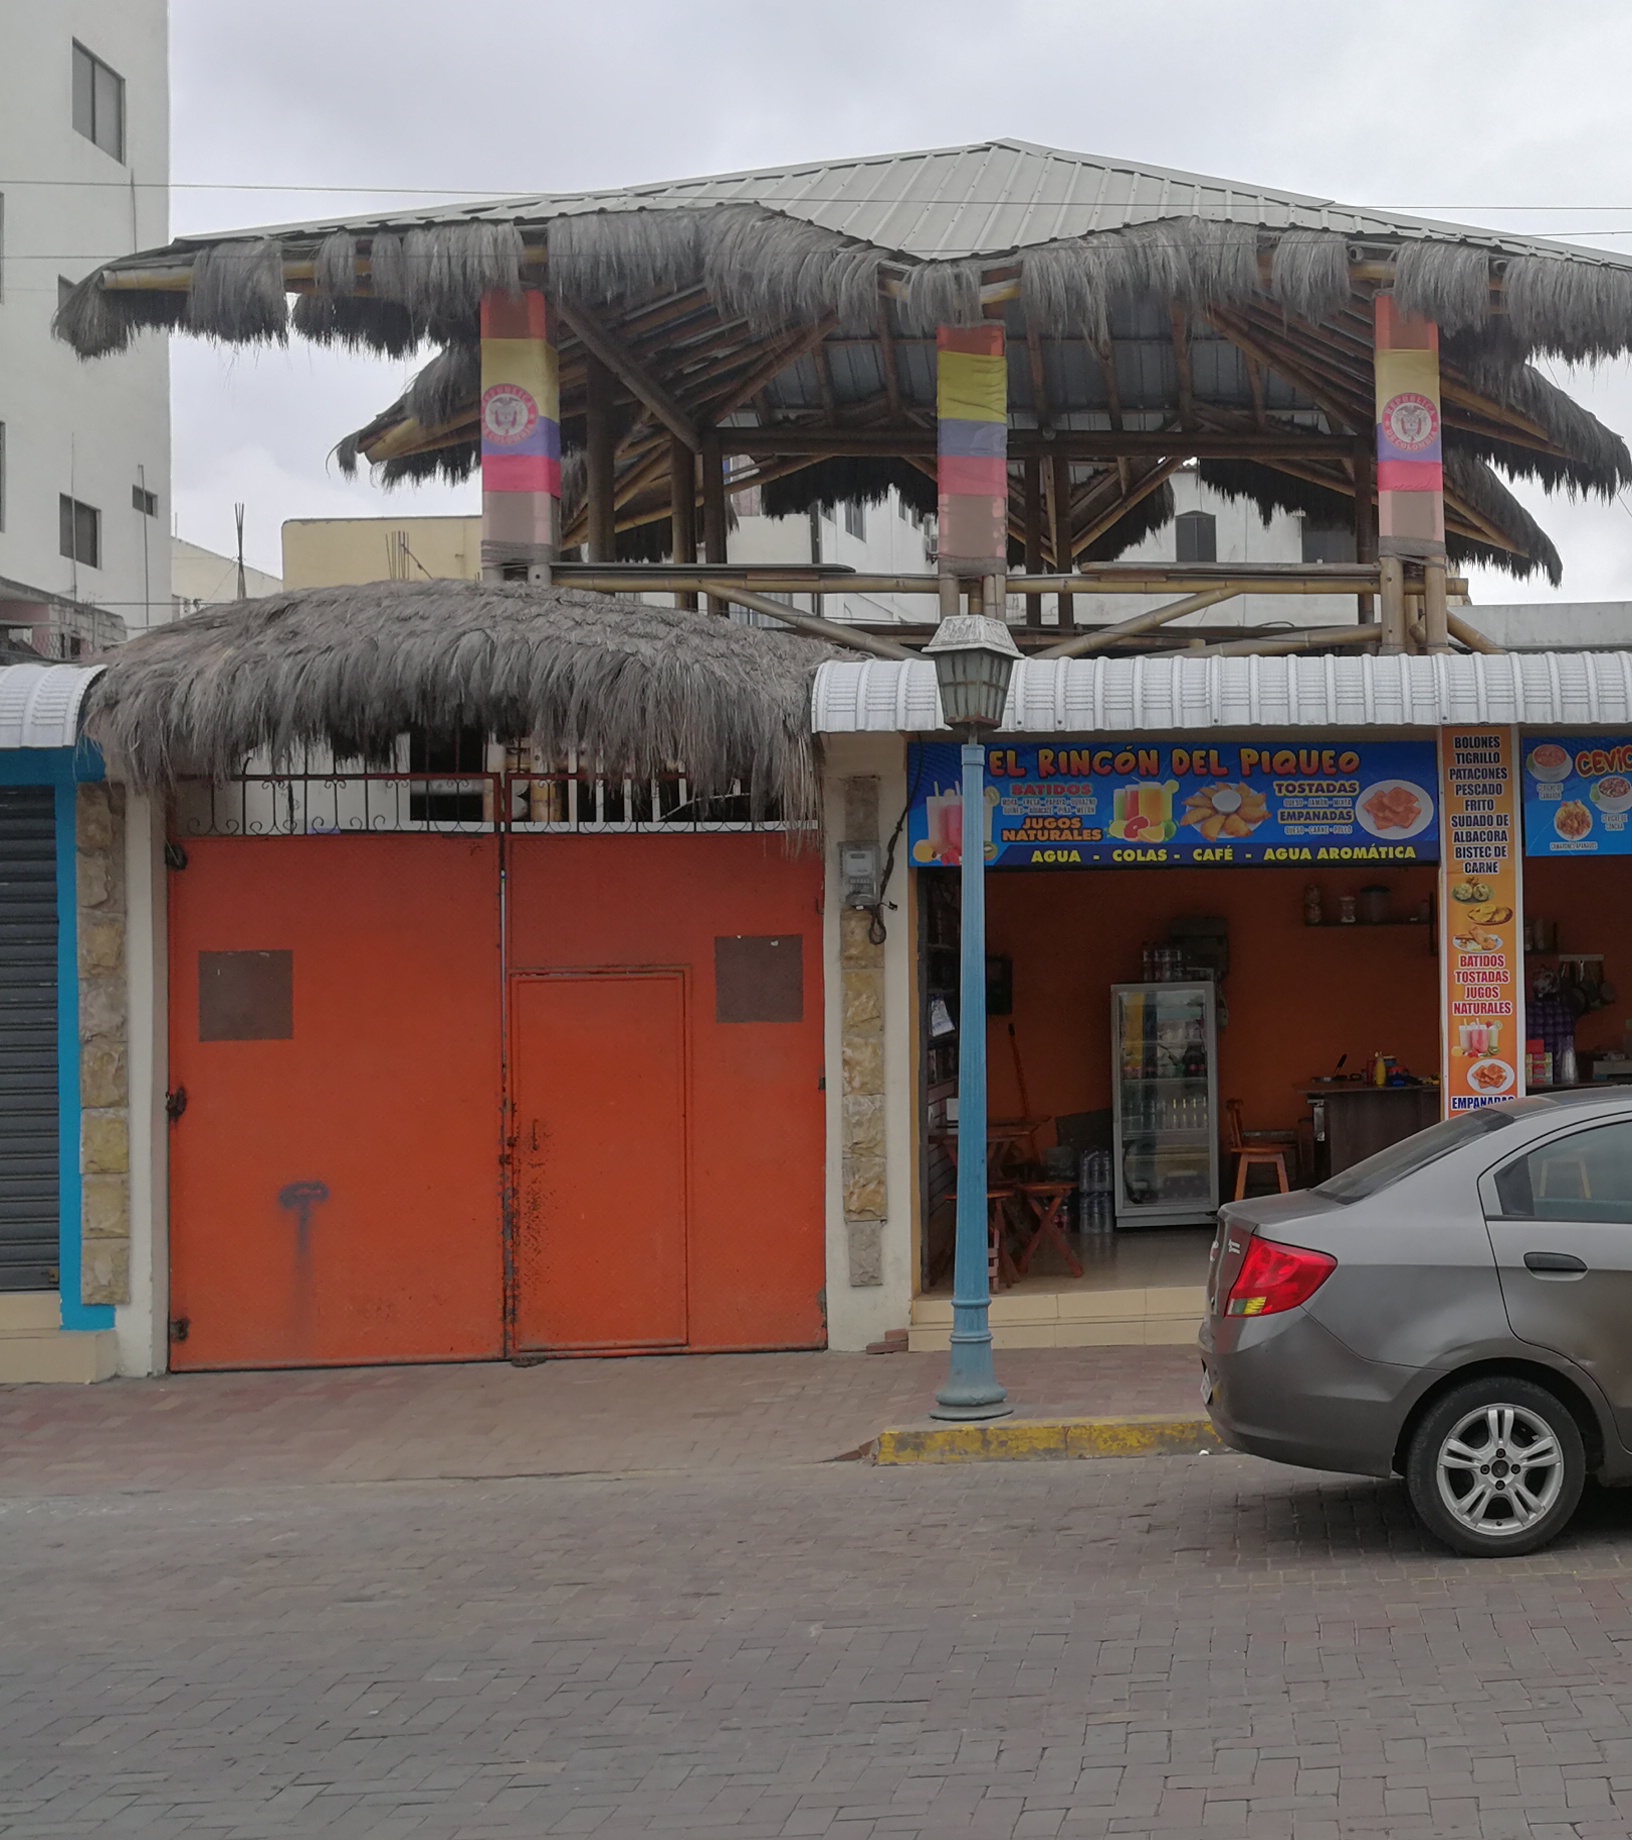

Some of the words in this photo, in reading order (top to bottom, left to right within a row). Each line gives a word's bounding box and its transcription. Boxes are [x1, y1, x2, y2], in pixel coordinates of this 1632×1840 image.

[1454, 736, 1501, 750] BOLONES
[988, 750, 1026, 777] EL
[1038, 745, 1160, 778] RINCÓN
[1171, 749, 1229, 776] DEL
[1240, 748, 1361, 776] PIQUEO
[1455, 752, 1501, 765] TIGRILLO
[1449, 767, 1508, 780] PATACONES
[1011, 783, 1093, 796] BATIDOS
[1274, 782, 1359, 795] TOSTADAS
[1455, 783, 1503, 796] PESCADO
[1465, 799, 1495, 812] FRITO
[1022, 817, 1083, 829] JUGOS
[1279, 811, 1353, 822] EMPANADAS
[1451, 815, 1494, 828] SUDADO
[1496, 814, 1509, 827] DE
[1002, 829, 1103, 842] NATURALES
[1453, 830, 1508, 844] ALBACORA
[1031, 850, 1081, 863] AGUA
[1112, 849, 1168, 862] COLAS
[1192, 845, 1233, 861] CAFÉ
[1263, 848, 1312, 861] AGUA
[1317, 844, 1417, 860] AROMÁTICA
[1455, 846, 1493, 859] BISTEC
[1494, 846, 1507, 858] DE
[1464, 861, 1499, 874] CARNE
[1459, 955, 1505, 968] BATIDOS
[1455, 971, 1509, 983] TOSTADAS
[1465, 986, 1499, 999] JUGOS
[1453, 1002, 1512, 1015] NATURALES
[1452, 1096, 1515, 1110] EMPANA
